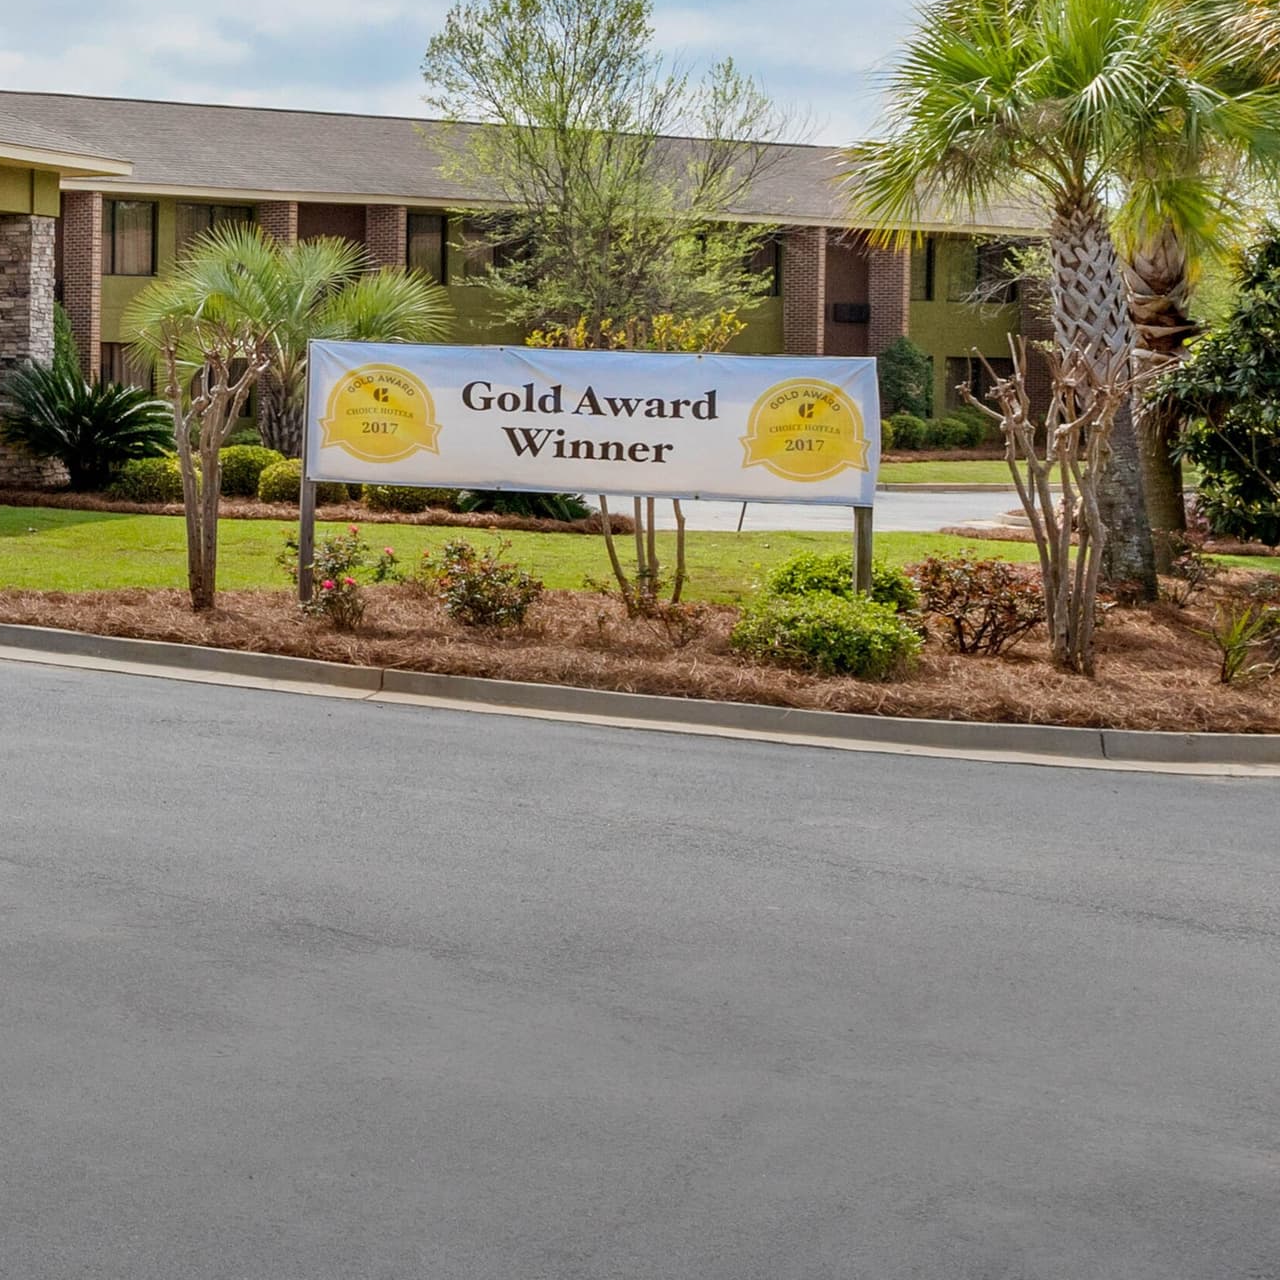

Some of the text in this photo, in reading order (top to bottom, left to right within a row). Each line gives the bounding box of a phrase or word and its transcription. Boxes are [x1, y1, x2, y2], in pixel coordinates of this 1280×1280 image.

[347, 375, 415, 397] GOLD AWARD
[462, 381, 719, 420] Gold Award
[770, 390, 841, 412] GOLD AWARD
[346, 407, 414, 419] CHOICE HOTELS
[362, 421, 399, 434] 2017
[769, 423, 841, 434] CHOICE HOTELS
[501, 426, 674, 463] Winner
[784, 439, 825, 452] 2017
